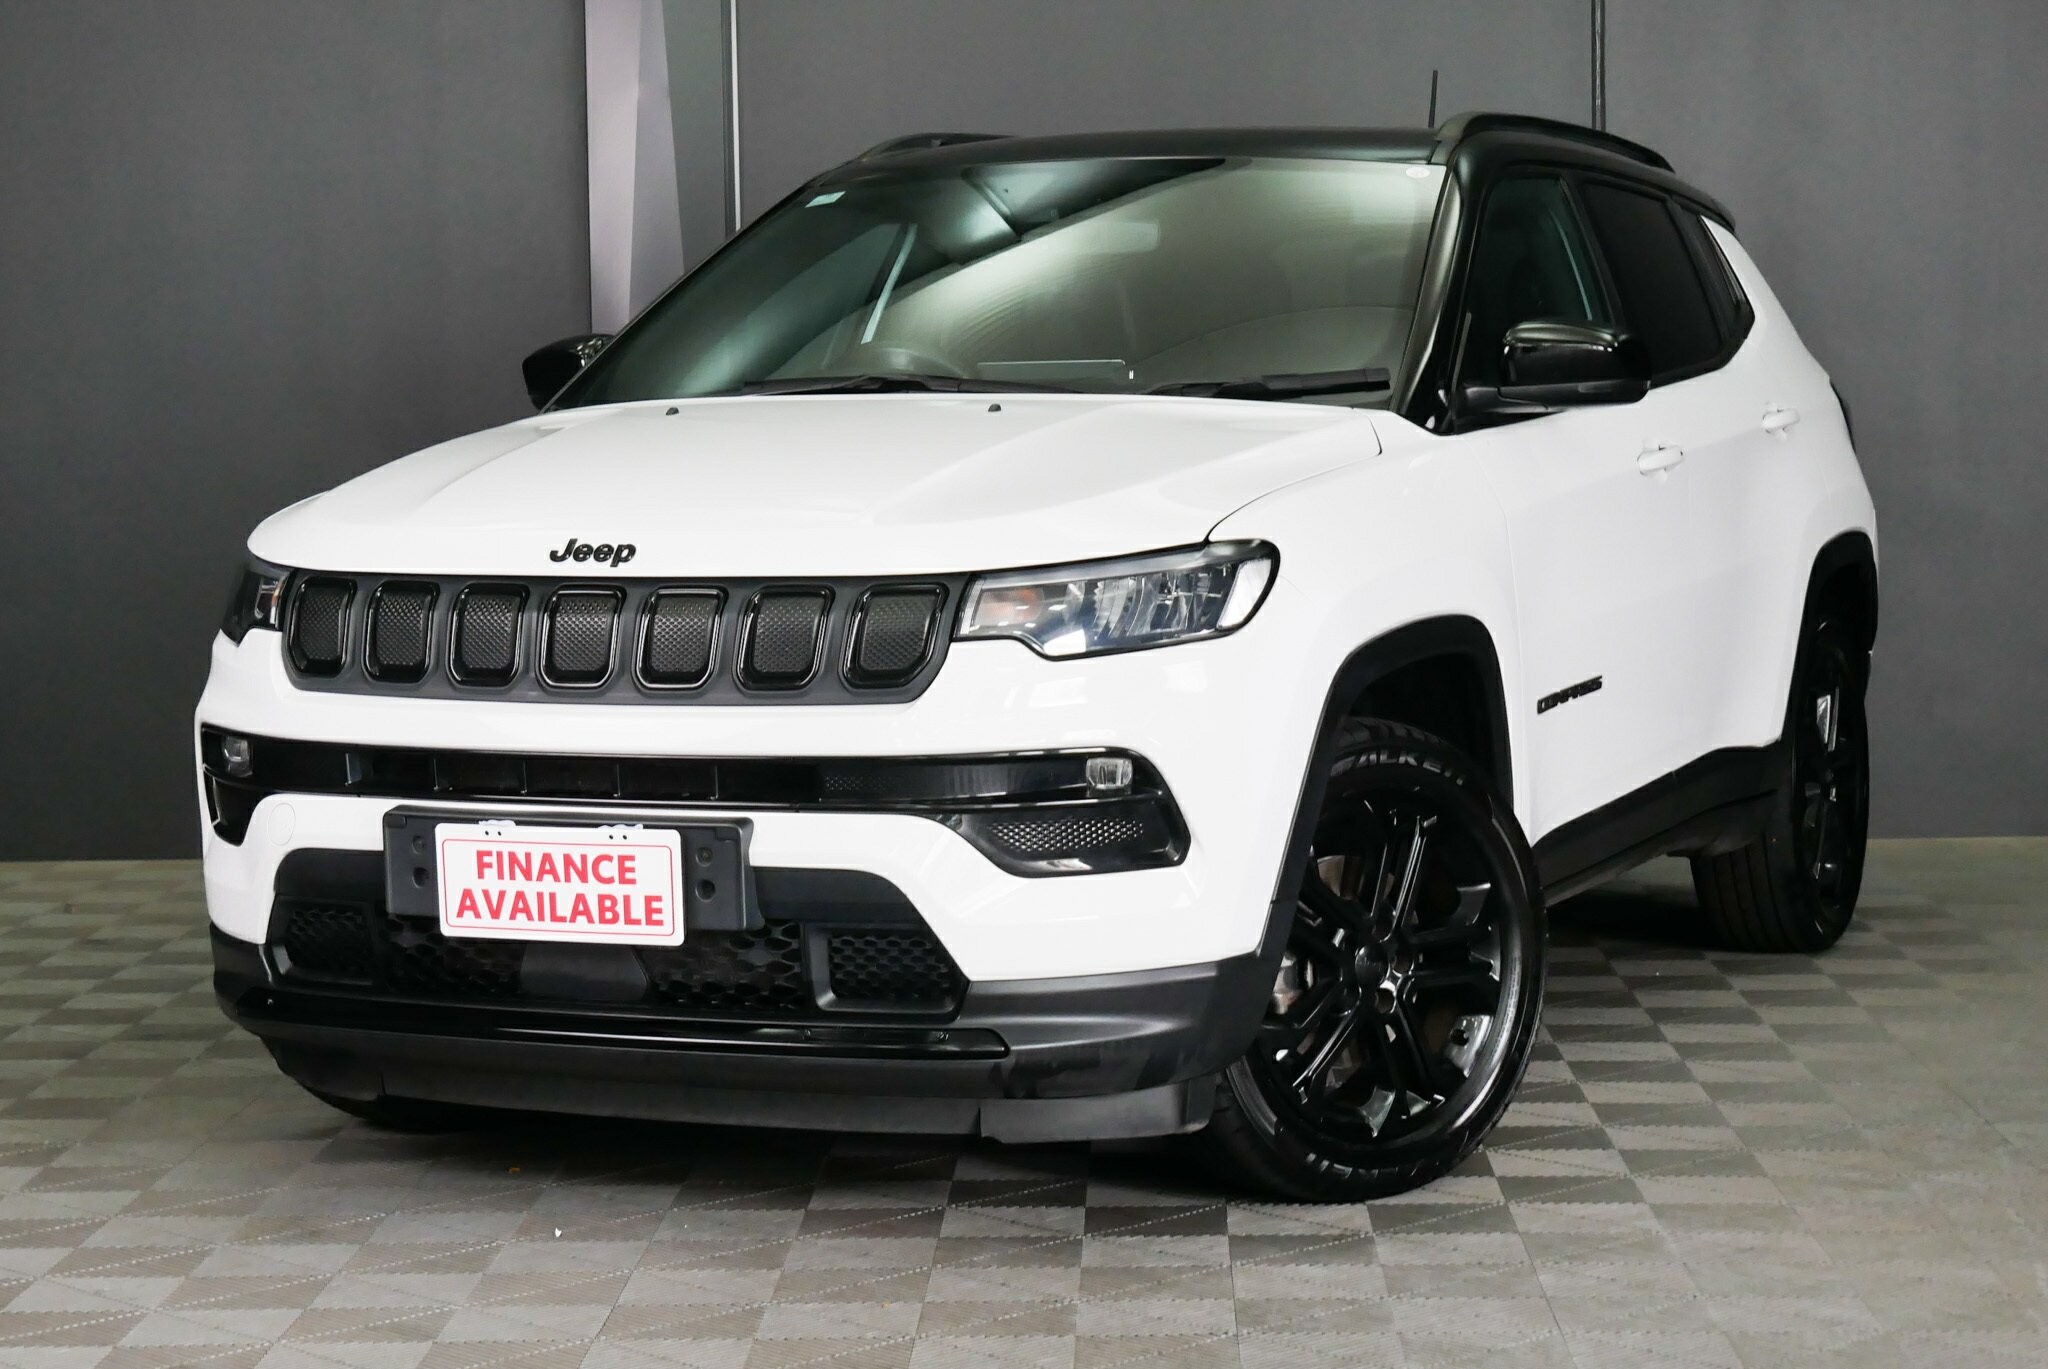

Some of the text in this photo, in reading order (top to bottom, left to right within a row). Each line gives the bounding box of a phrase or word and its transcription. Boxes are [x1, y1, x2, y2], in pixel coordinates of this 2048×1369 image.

[549, 538, 636, 567] Jeep
[476, 850, 637, 885] FINANCE
[455, 888, 664, 926] AVAILABLE
